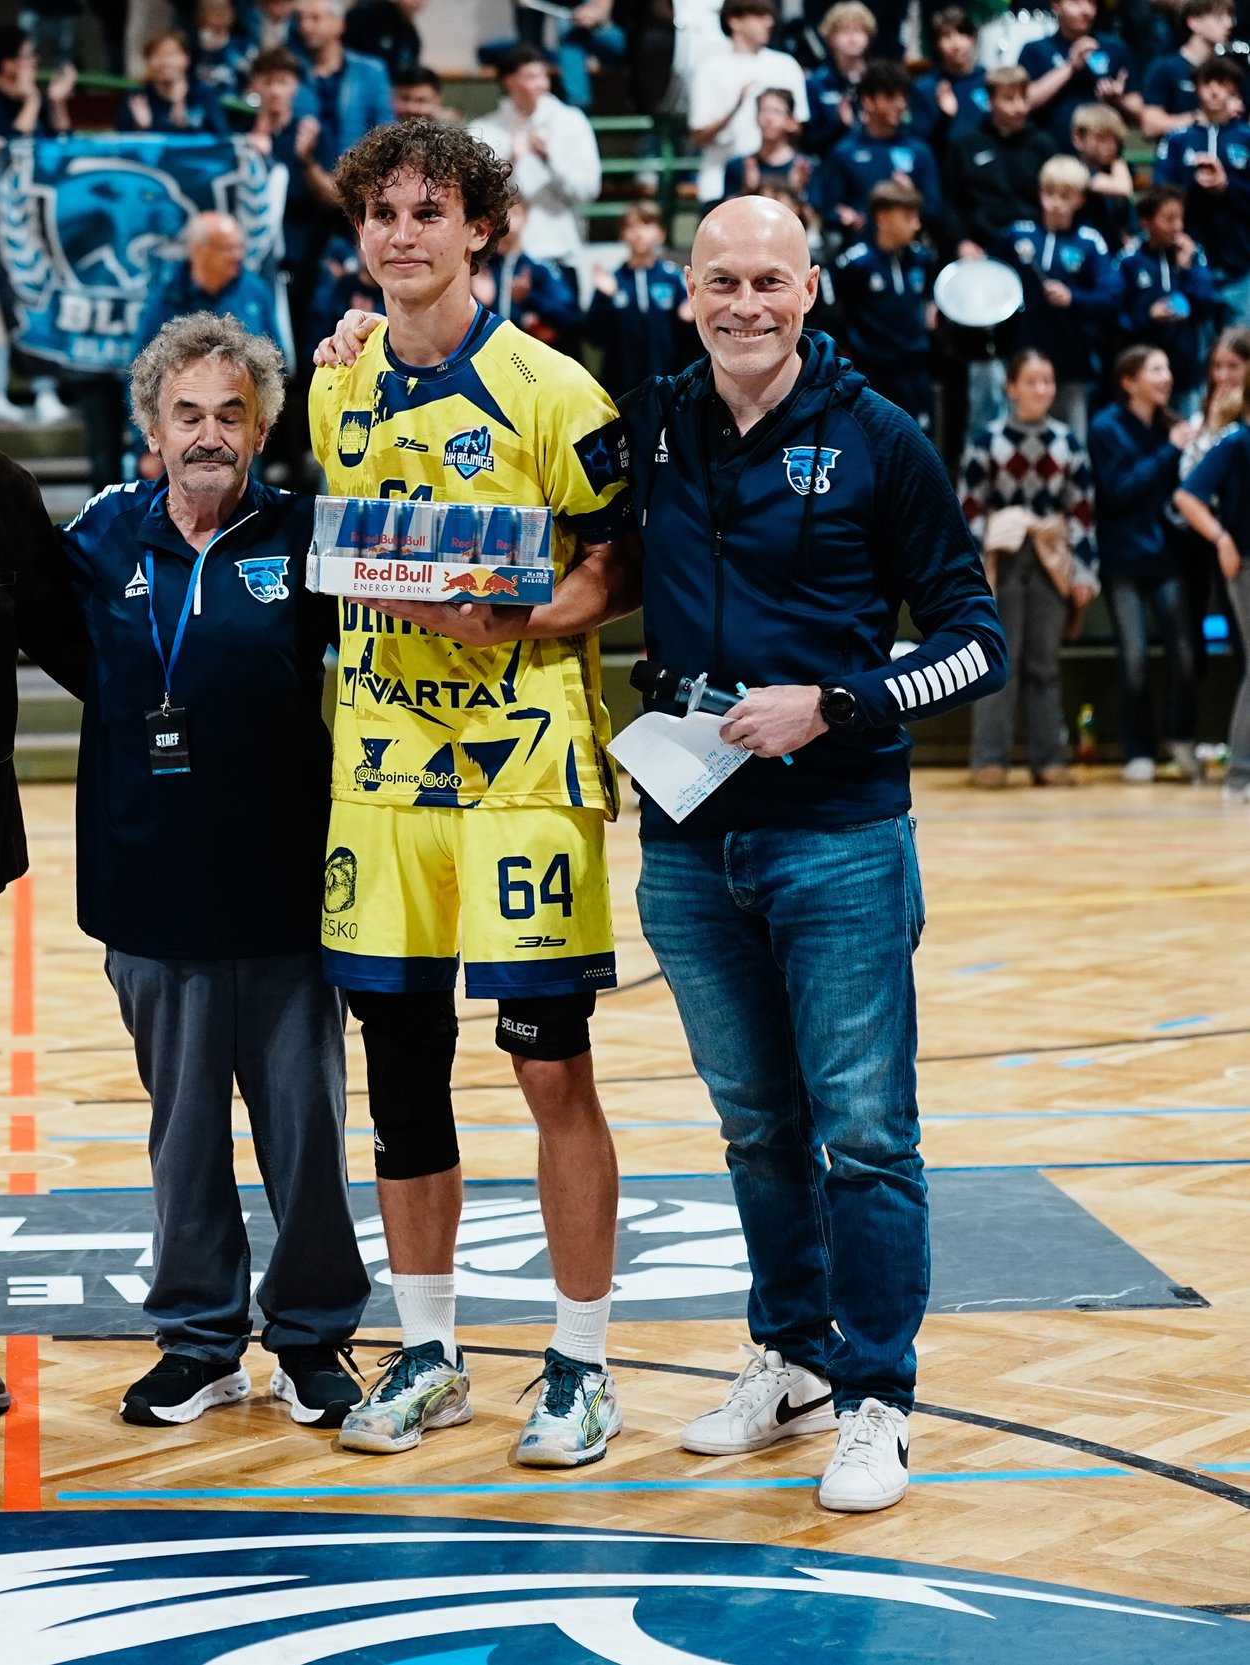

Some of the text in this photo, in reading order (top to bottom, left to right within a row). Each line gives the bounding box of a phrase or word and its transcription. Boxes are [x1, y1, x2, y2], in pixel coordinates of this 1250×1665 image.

[354, 561, 433, 583] Red Bull
[353, 582, 431, 594] ENERGY DRINK
[364, 676, 501, 709] VARTA
[155, 732, 180, 747] STAFF
[356, 767, 420, 785] @hkbojnice
[497, 853, 574, 920] 64
[501, 1016, 539, 1038] SELECT
